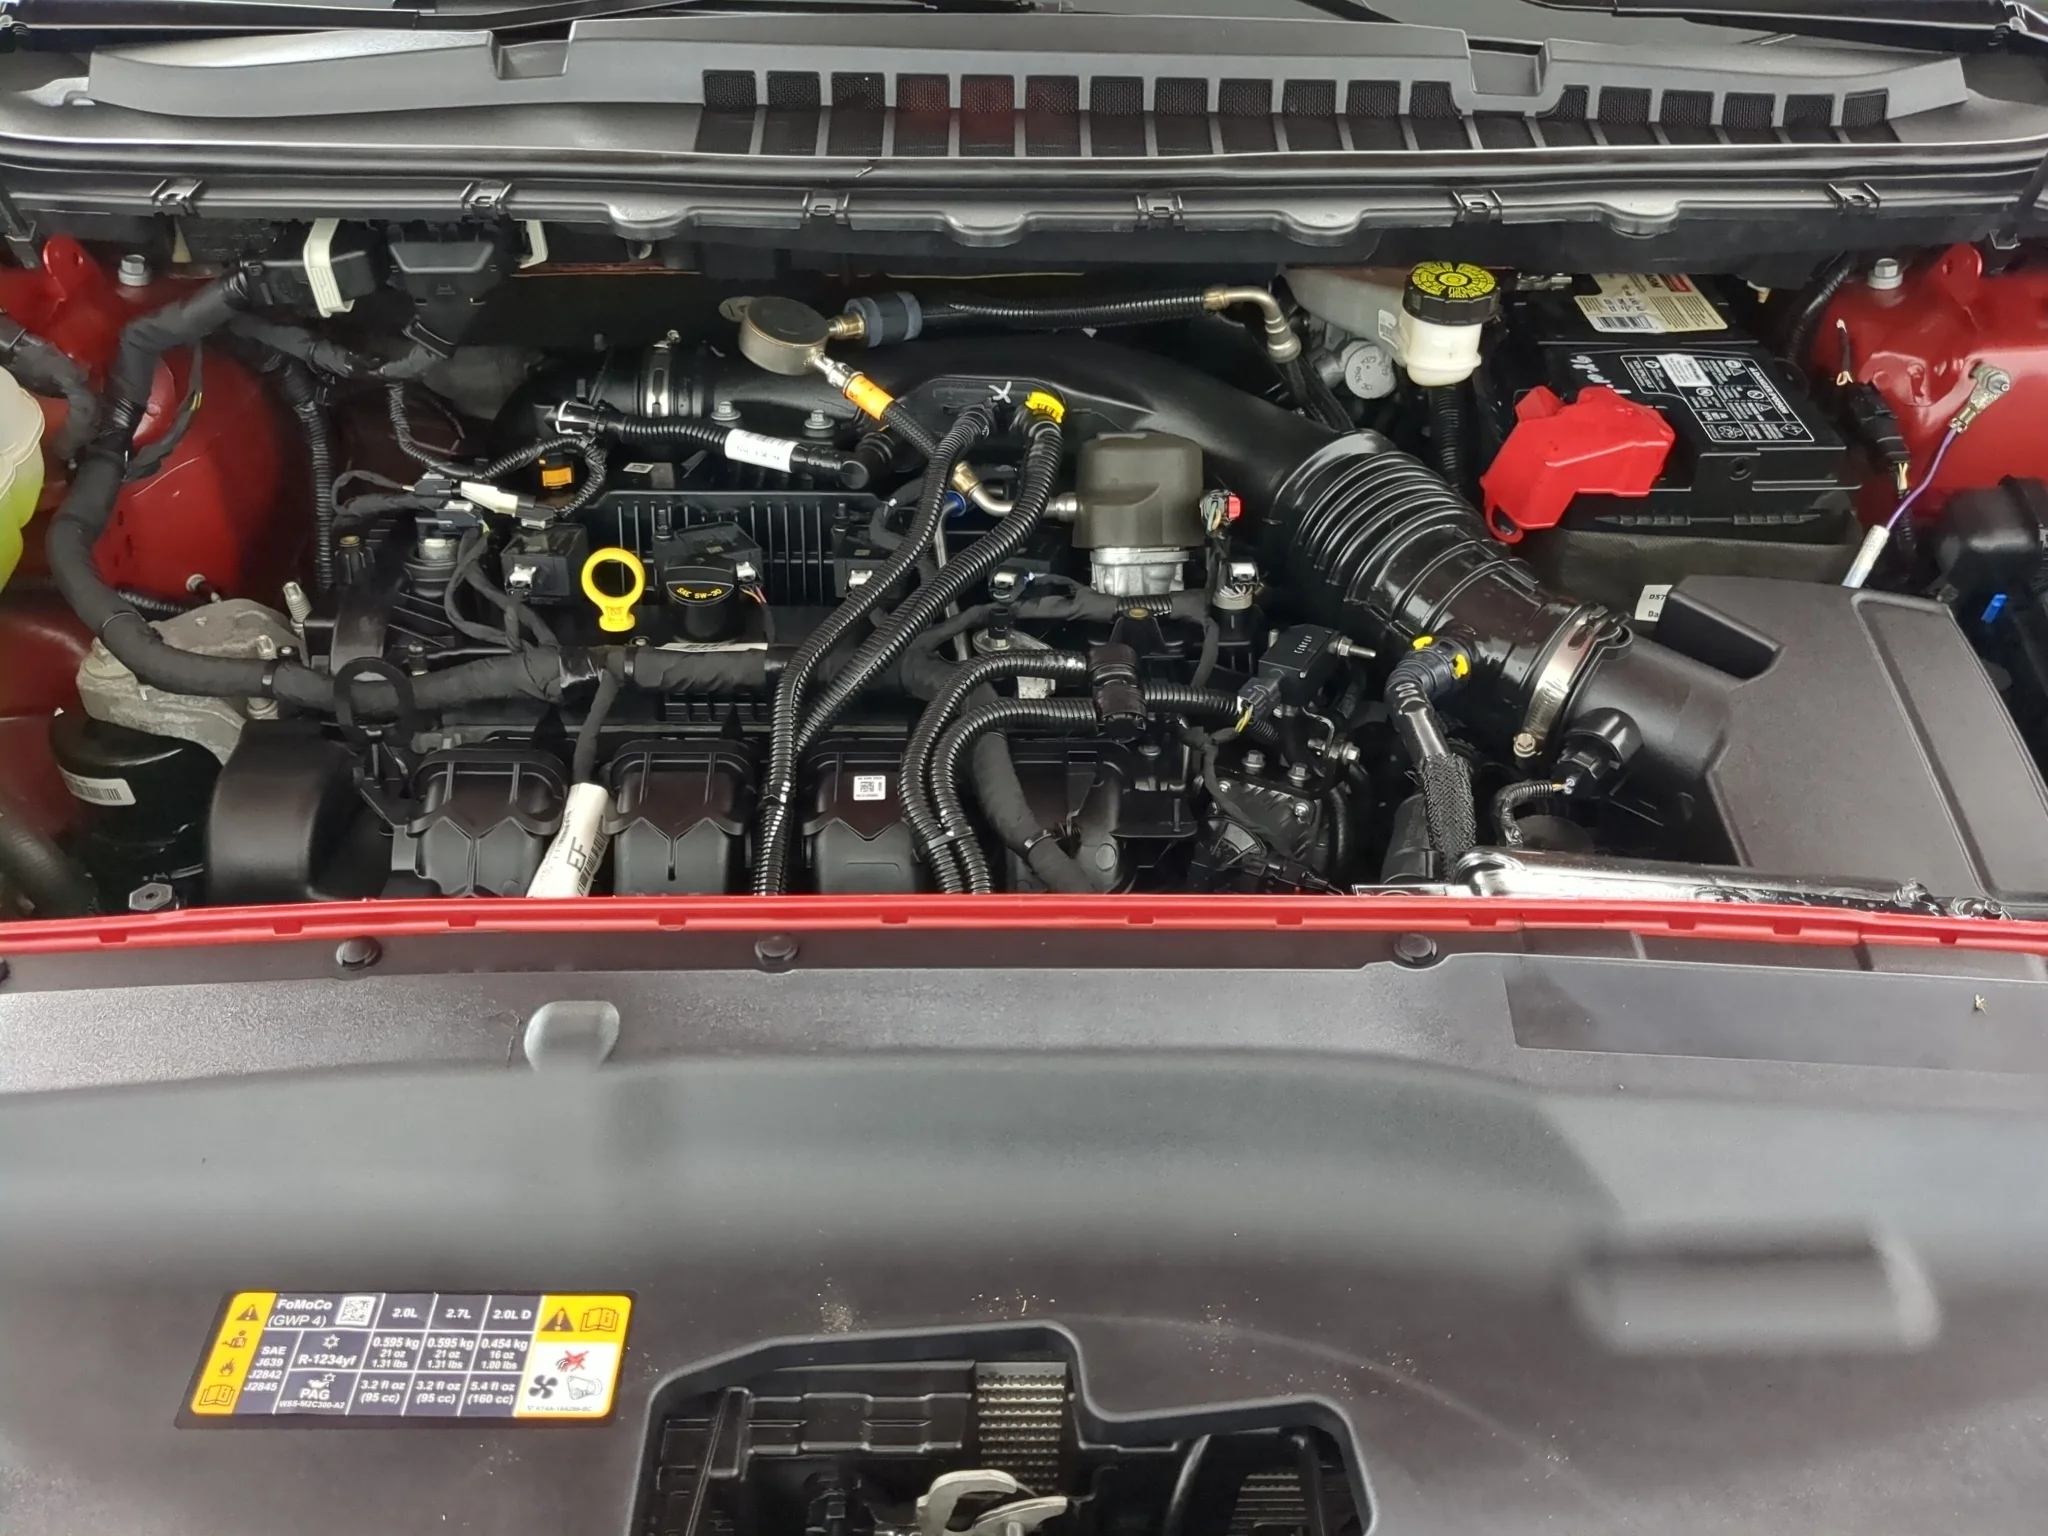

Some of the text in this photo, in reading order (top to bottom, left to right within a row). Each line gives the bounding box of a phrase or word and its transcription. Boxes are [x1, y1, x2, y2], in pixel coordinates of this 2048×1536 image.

[676, 587, 723, 599] SAE 5W-30
[566, 836, 587, 873] EF
[277, 1299, 333, 1310] FoMoCo
[391, 1307, 419, 1319] 2.0L
[445, 1308, 472, 1320] 2.7L
[492, 1309, 532, 1320] 2.0L D
[268, 1315, 327, 1329] (GWP 4)
[372, 1336, 421, 1351] 0.595 kg
[427, 1337, 475, 1351] 0.595 kg
[480, 1338, 529, 1352] 0.454 kg
[260, 1346, 288, 1355] SAE
[380, 1349, 407, 1359] 21 oz
[434, 1350, 461, 1359] 21 oz
[490, 1351, 516, 1360] 16 oz
[255, 1358, 284, 1367] J639
[297, 1354, 357, 1368] R-1234yf
[372, 1359, 409, 1369] 1.31 lbs
[427, 1360, 464, 1369] 1.31 lbs
[482, 1361, 518, 1370] 1.00 lbs
[248, 1370, 283, 1380] J2842
[243, 1382, 278, 1392] J2845
[361, 1380, 407, 1391] 3.2 fl oz
[416, 1381, 462, 1391] 3.2 fl oz
[470, 1381, 516, 1392] 5.4 fl oz
[300, 1388, 331, 1400] PAG
[361, 1392, 401, 1405] (95 cc)
[416, 1393, 456, 1405] (95 cc)
[467, 1393, 514, 1405] (160 cc)
